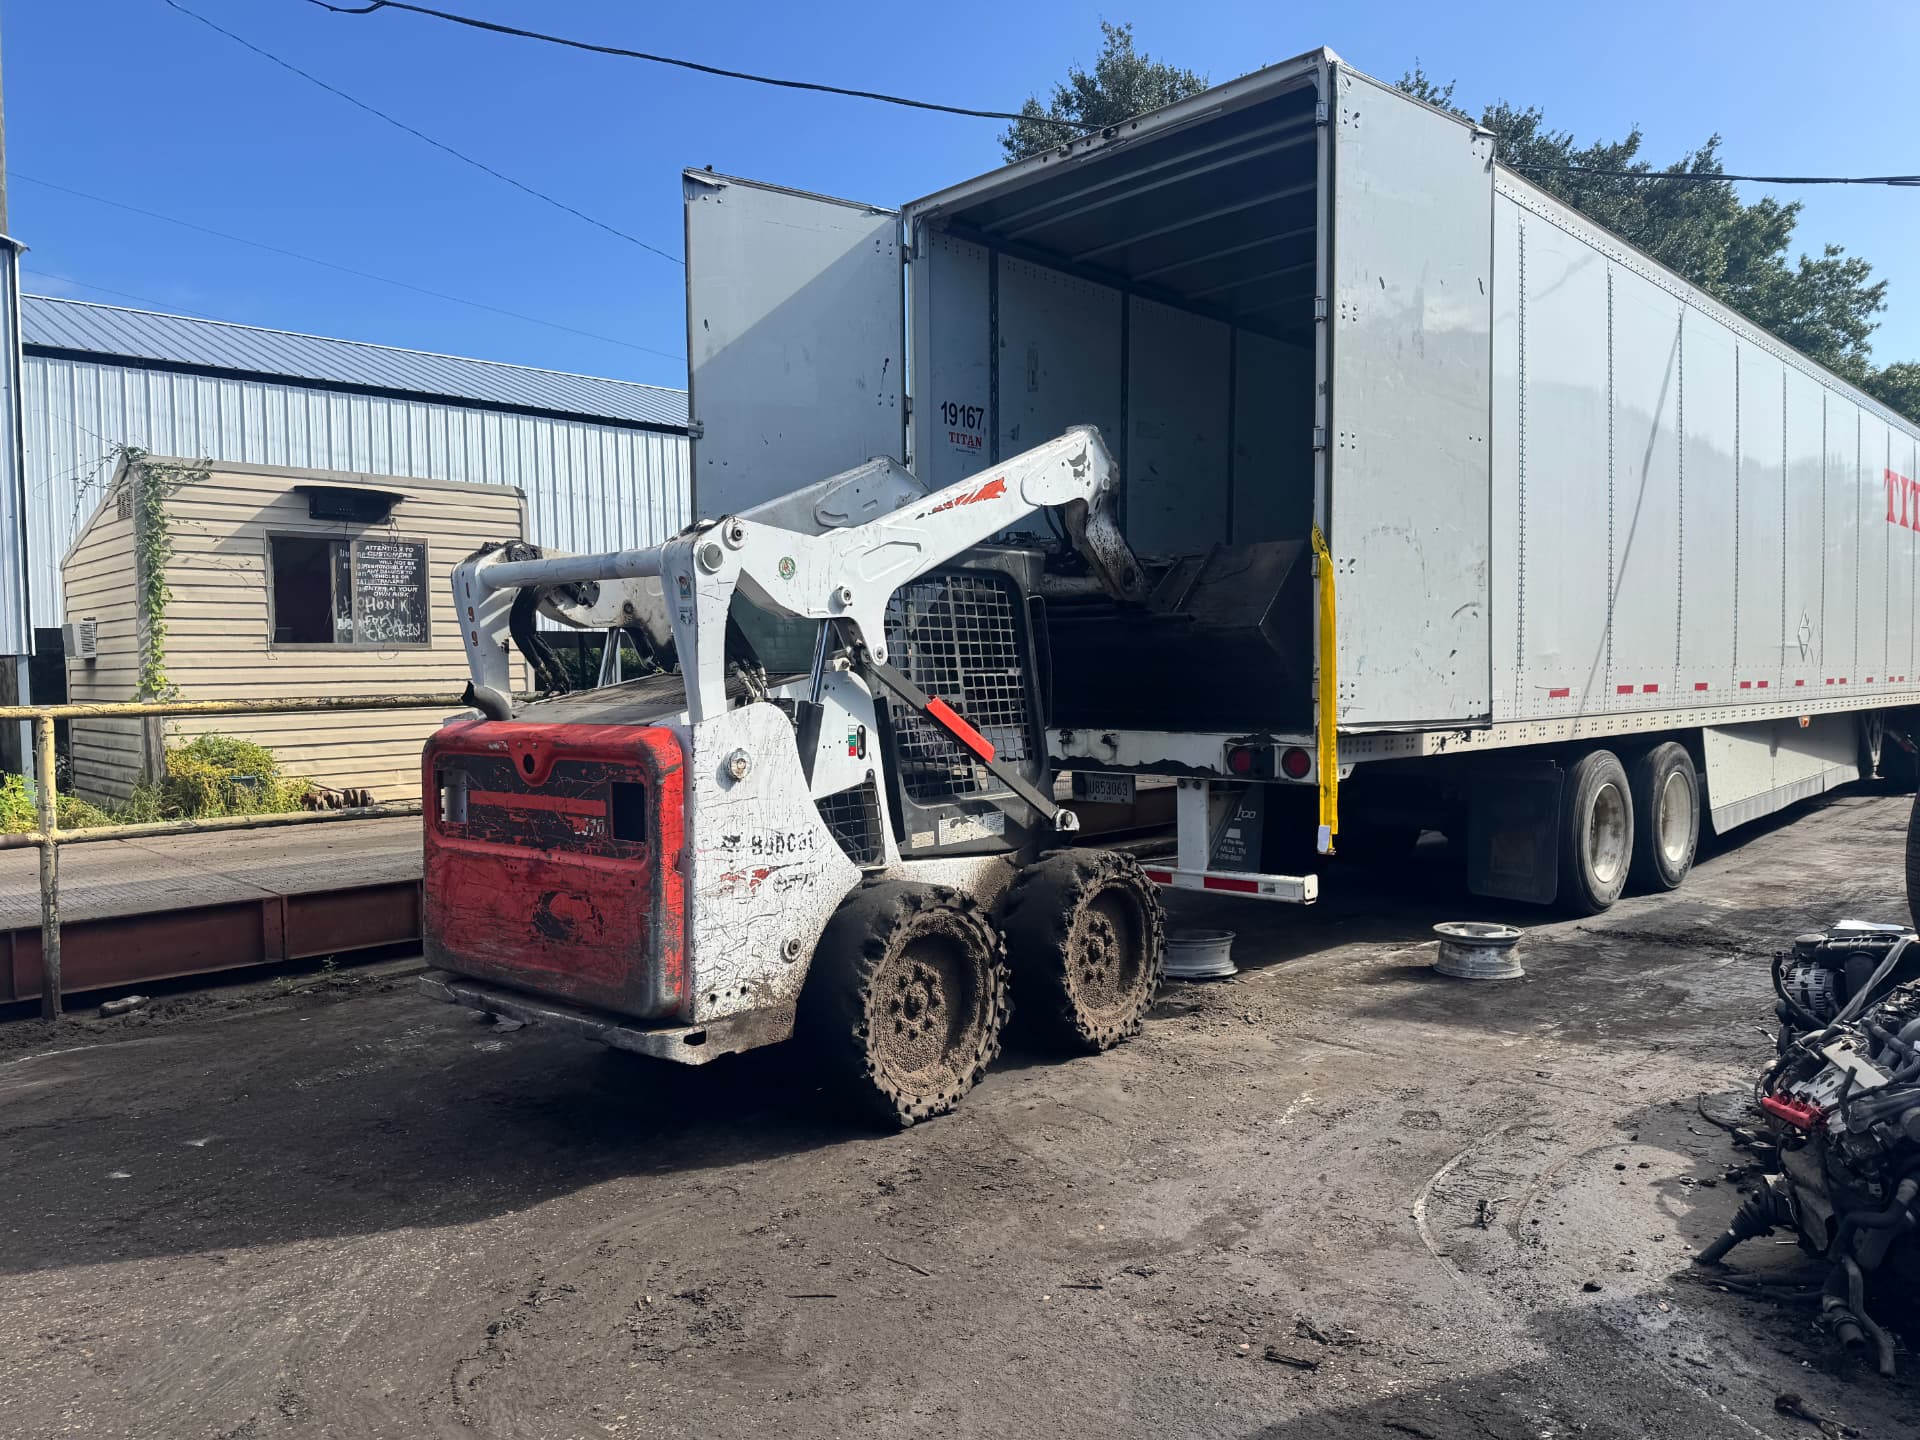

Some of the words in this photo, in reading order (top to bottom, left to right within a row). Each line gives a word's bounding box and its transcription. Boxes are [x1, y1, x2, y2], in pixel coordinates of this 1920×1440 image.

[940, 401, 985, 431] 19167
[948, 431, 983, 449] TITAN
[364, 544, 403, 552] ATTENTION
